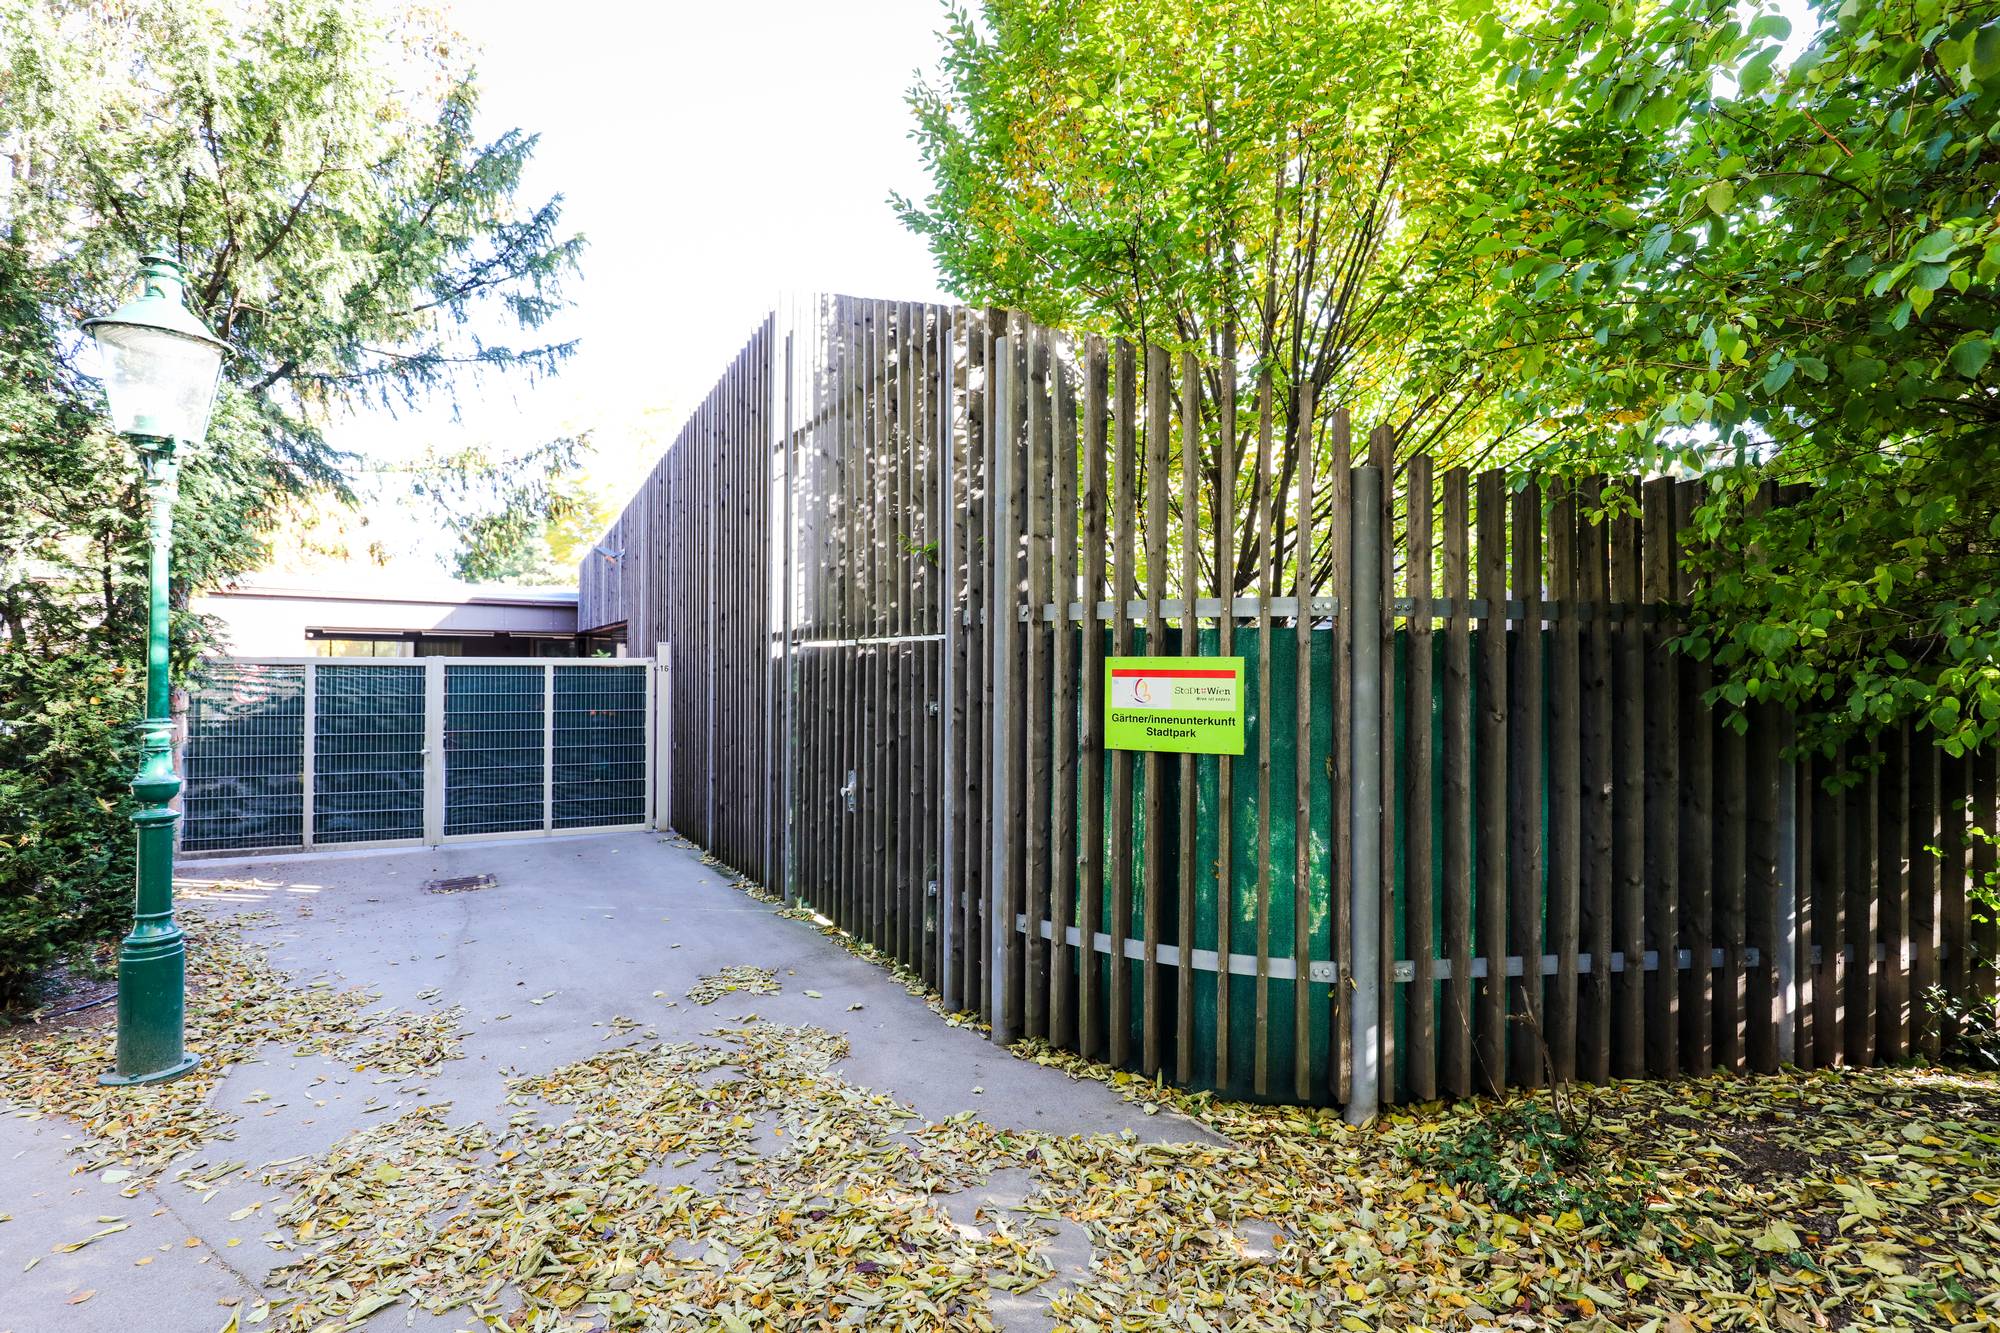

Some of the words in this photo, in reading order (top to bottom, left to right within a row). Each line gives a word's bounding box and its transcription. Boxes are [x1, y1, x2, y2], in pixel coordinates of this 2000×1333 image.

[1207, 686, 1231, 695] Wien
[1111, 713, 1236, 726] Gärtner/innenunterkunft
[1146, 727, 1196, 739] Stadtpark
